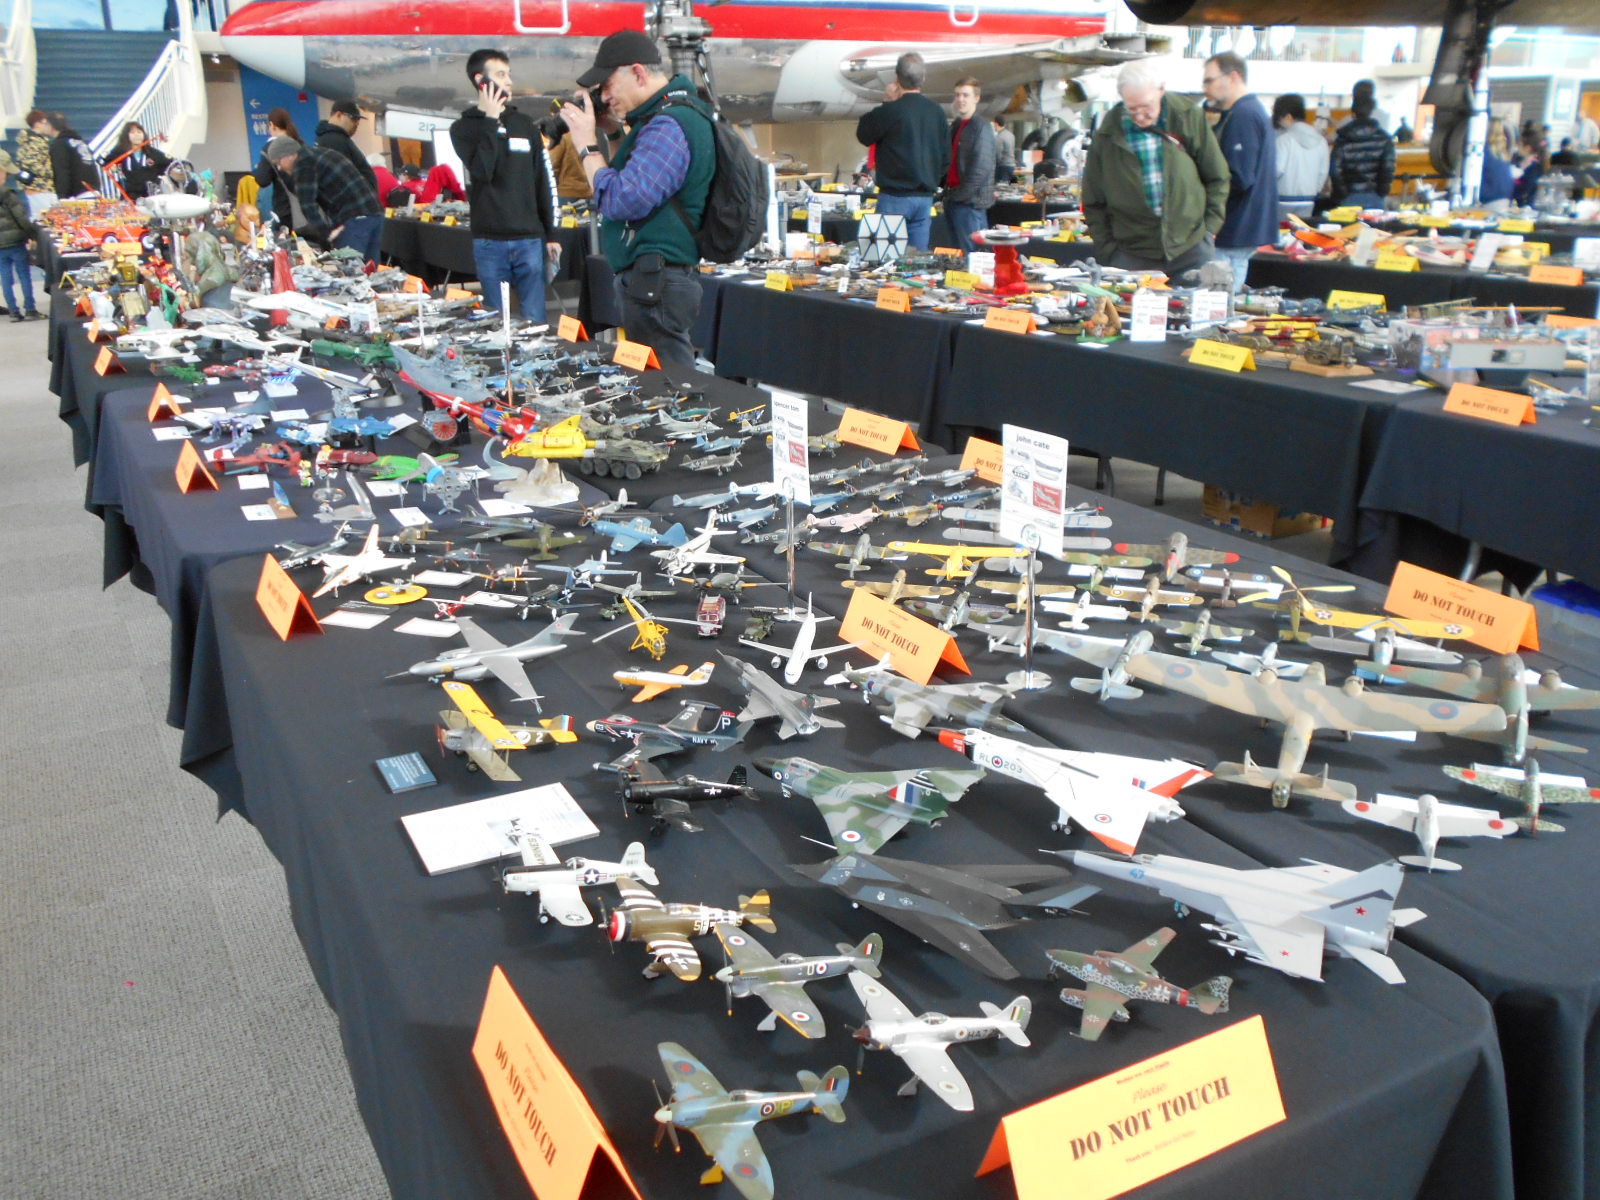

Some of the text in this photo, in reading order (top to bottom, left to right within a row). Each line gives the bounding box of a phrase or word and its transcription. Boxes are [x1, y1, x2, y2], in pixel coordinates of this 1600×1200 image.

[1472, 401, 1485, 409] NOT
[1486, 403, 1509, 414] TOUCH
[850, 425, 888, 442] DO NOT TOUCH
[1016, 433, 1050, 450] john cate
[976, 457, 984, 466] DO
[984, 460, 997, 471] NOT
[1412, 589, 1428, 603] DO
[1430, 595, 1452, 612] NOT
[1456, 603, 1496, 627] TOUCH
[861, 616, 874, 631] DO
[873, 622, 891, 641] NOT
[890, 632, 921, 657] TOUCH
[535, 732, 544, 743] 2
[692, 735, 708, 745] NAVY
[978, 752, 1024, 774] RL 203
[495, 1040, 509, 1071] DO
[506, 1063, 526, 1105] NOT
[524, 1096, 557, 1169] TOUCH
[1070, 1130, 1102, 1162] DO
[1107, 1108, 1152, 1146] NOT
[1157, 1076, 1231, 1122] TOUCH
